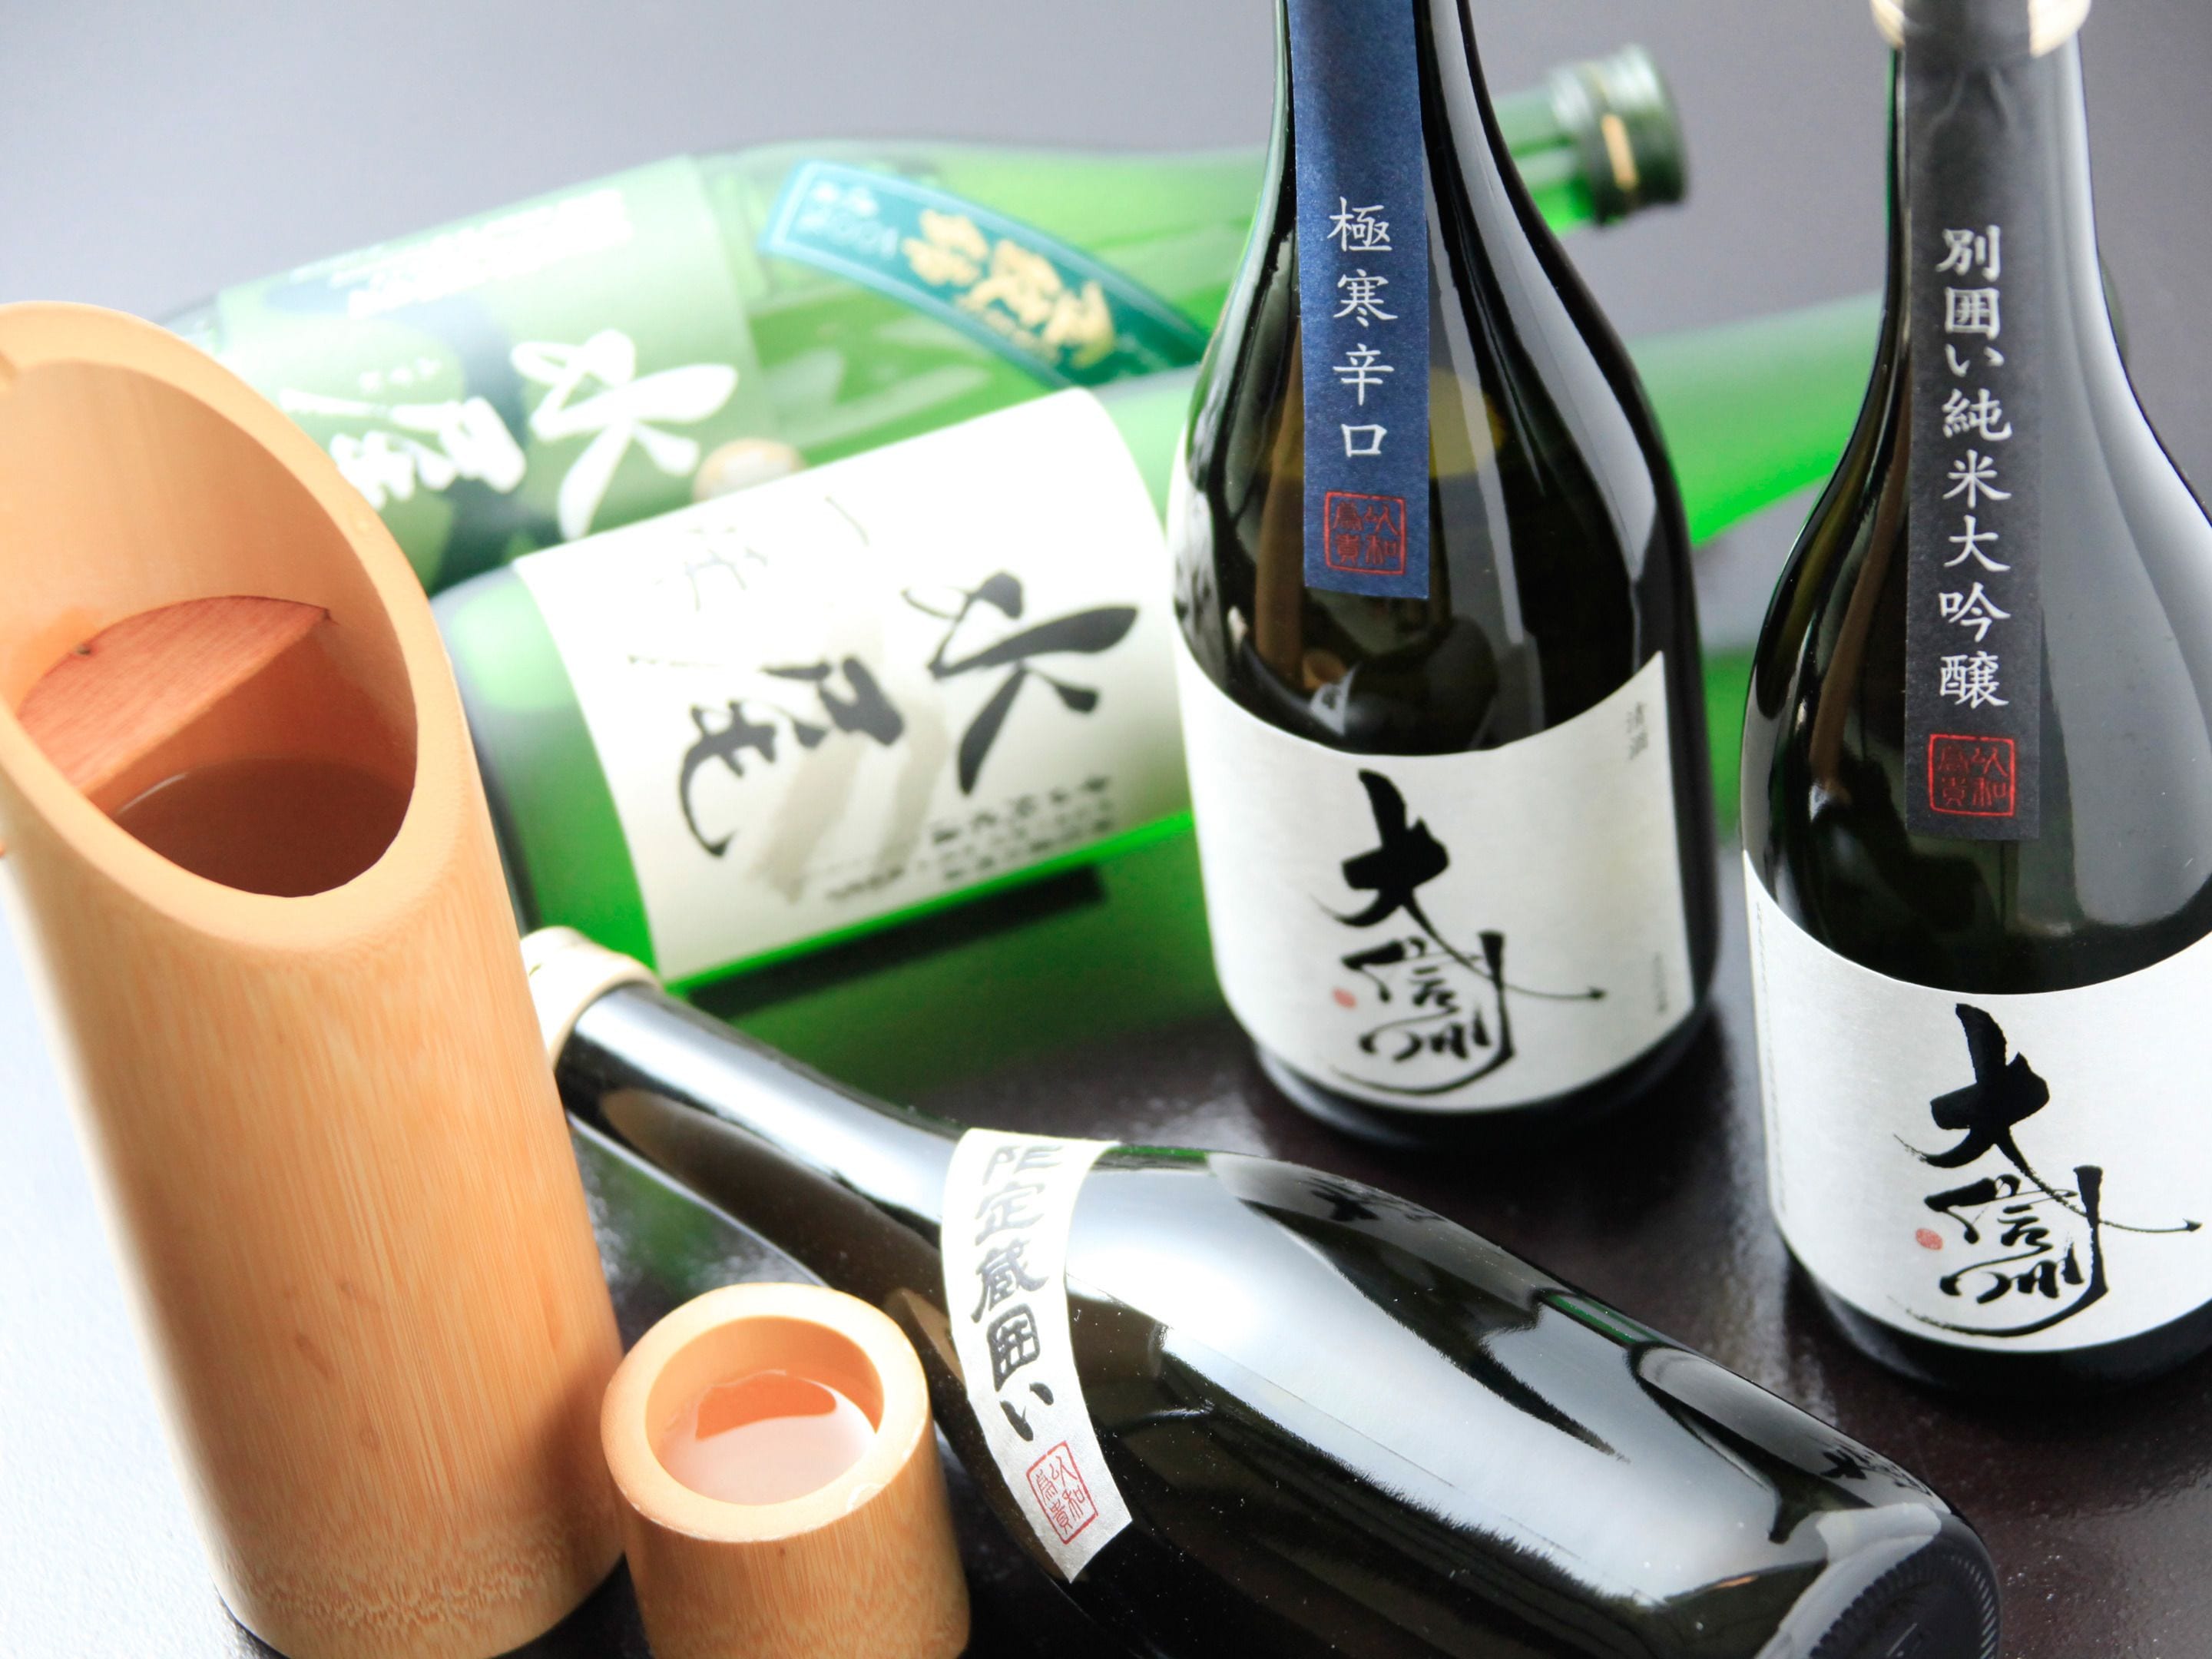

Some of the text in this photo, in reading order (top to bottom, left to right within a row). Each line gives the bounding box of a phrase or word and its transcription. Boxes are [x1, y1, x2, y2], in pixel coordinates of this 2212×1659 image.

[1328, 196, 1397, 459] 極寒辛口
[1936, 225, 2012, 710] 別囲い純米大吟醸
[971, 1145, 1064, 1442] 限定蔵囲い
